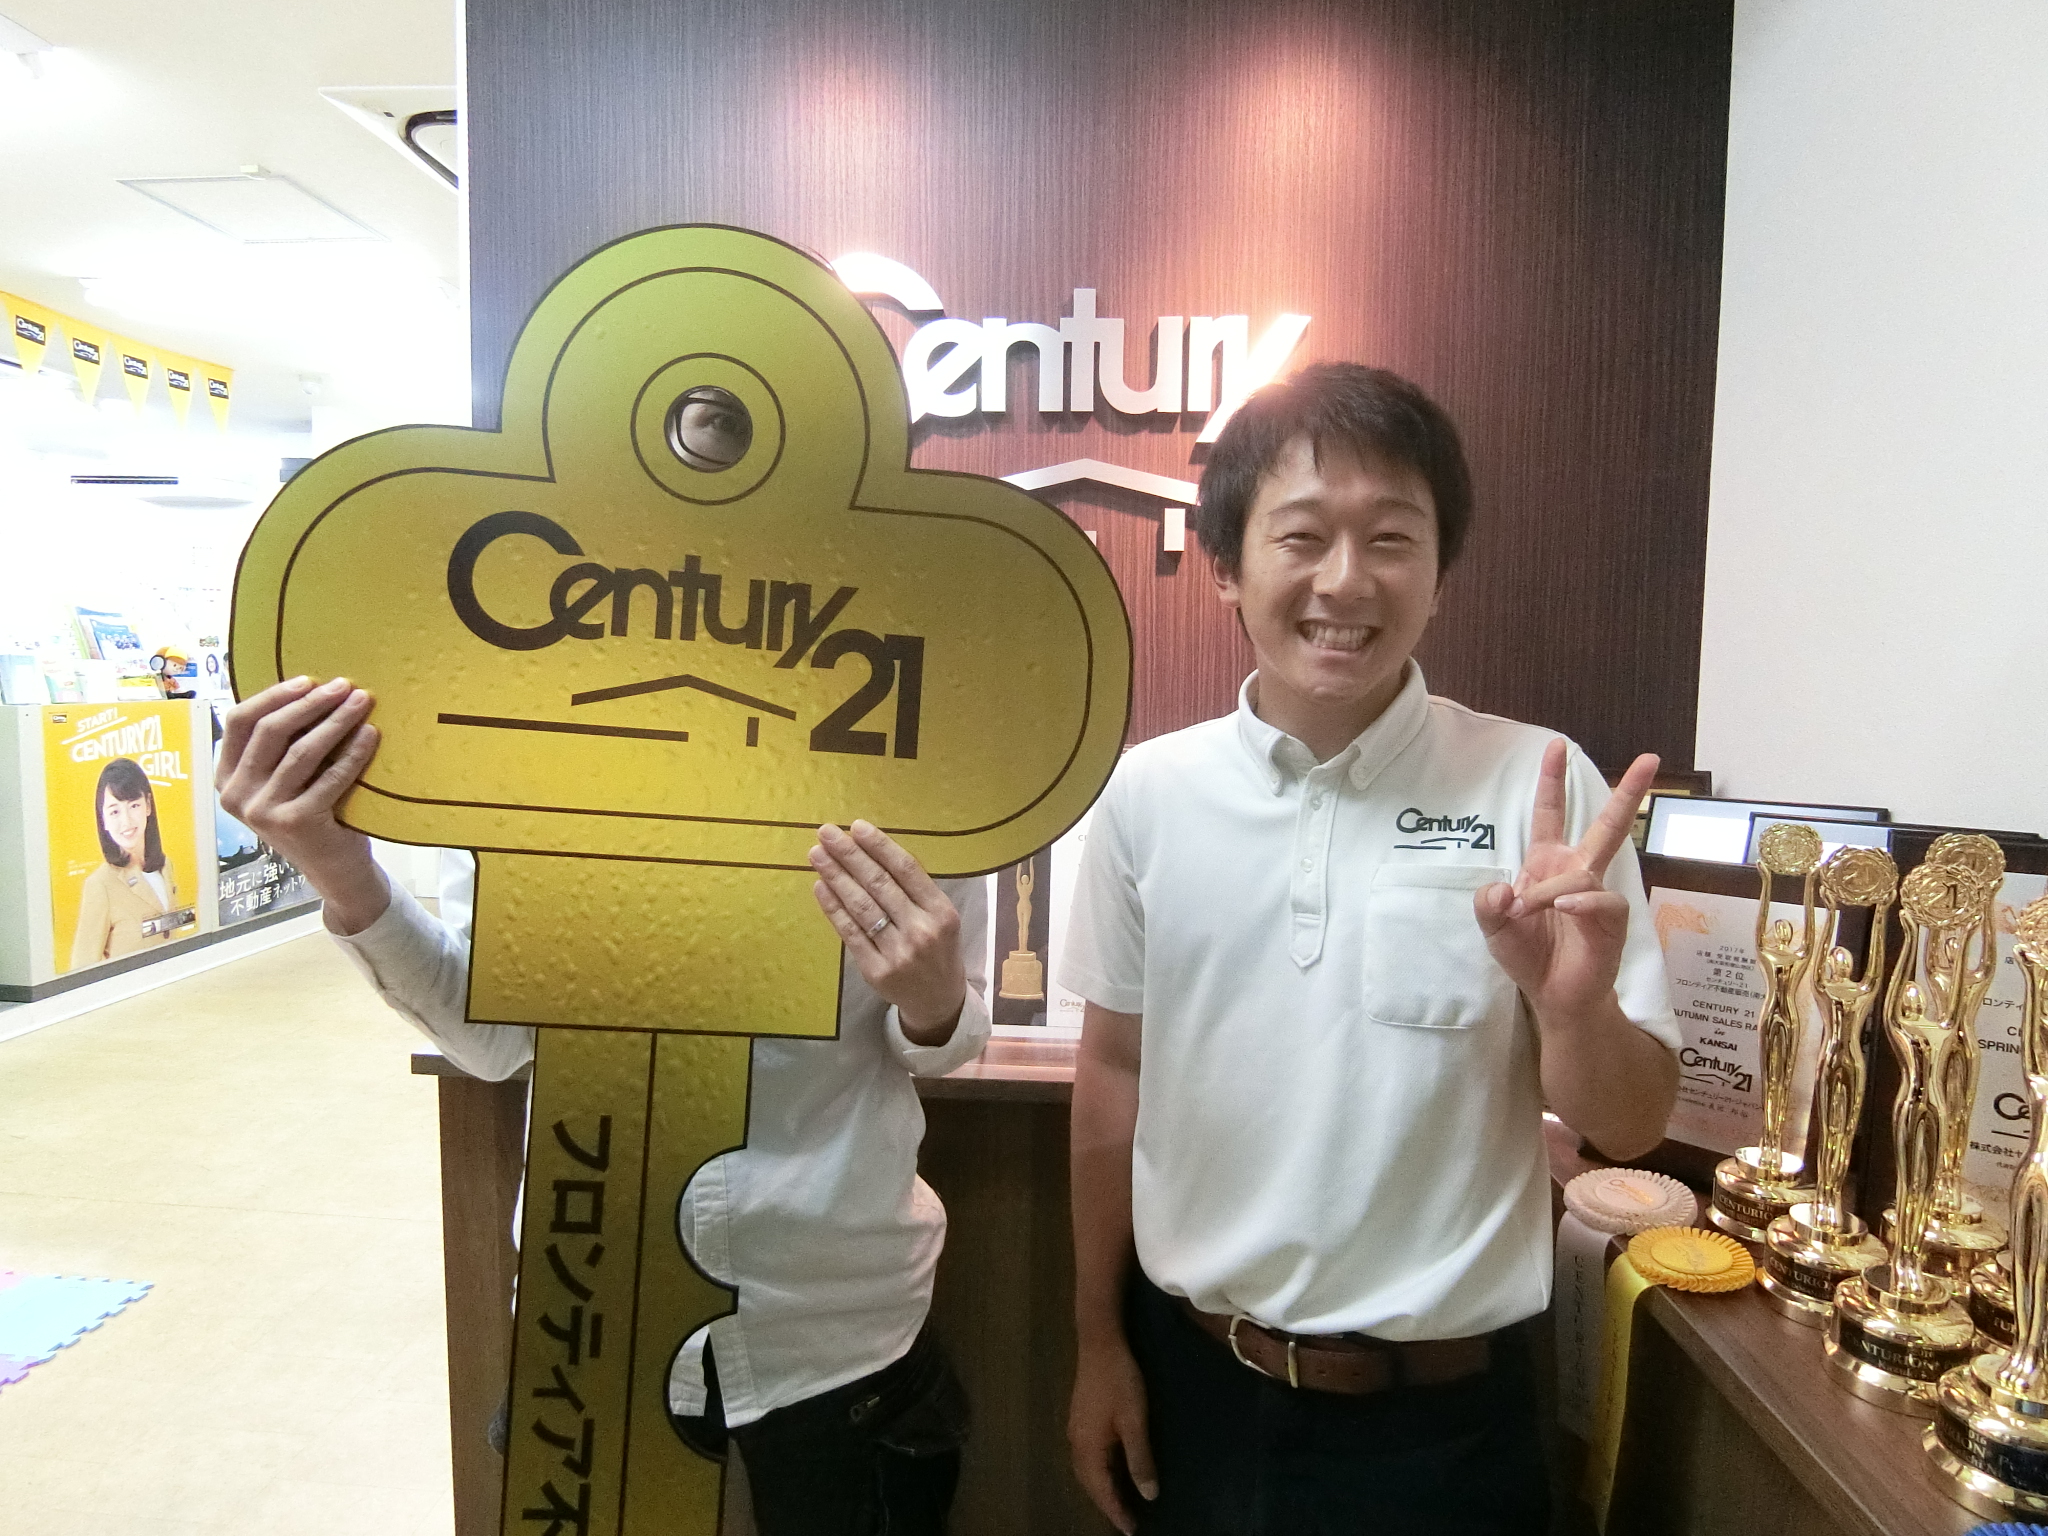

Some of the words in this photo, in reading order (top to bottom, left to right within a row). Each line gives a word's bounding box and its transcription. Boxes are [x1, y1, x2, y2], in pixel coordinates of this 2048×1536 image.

[447, 510, 859, 669] Century
[809, 628, 925, 759] 21
[140, 750, 188, 780] GIRL
[1396, 807, 1480, 833] Century
[1470, 823, 1495, 850] 21
[1692, 1000, 1739, 1015] CENTURY
[1744, 1009, 1755, 1019] 21
[1712, 1016, 1743, 1029] SALES
[1699, 1036, 1738, 1052] KANSAI
[1680, 1047, 1742, 1076] Century
[1732, 1072, 1753, 1092] 21
